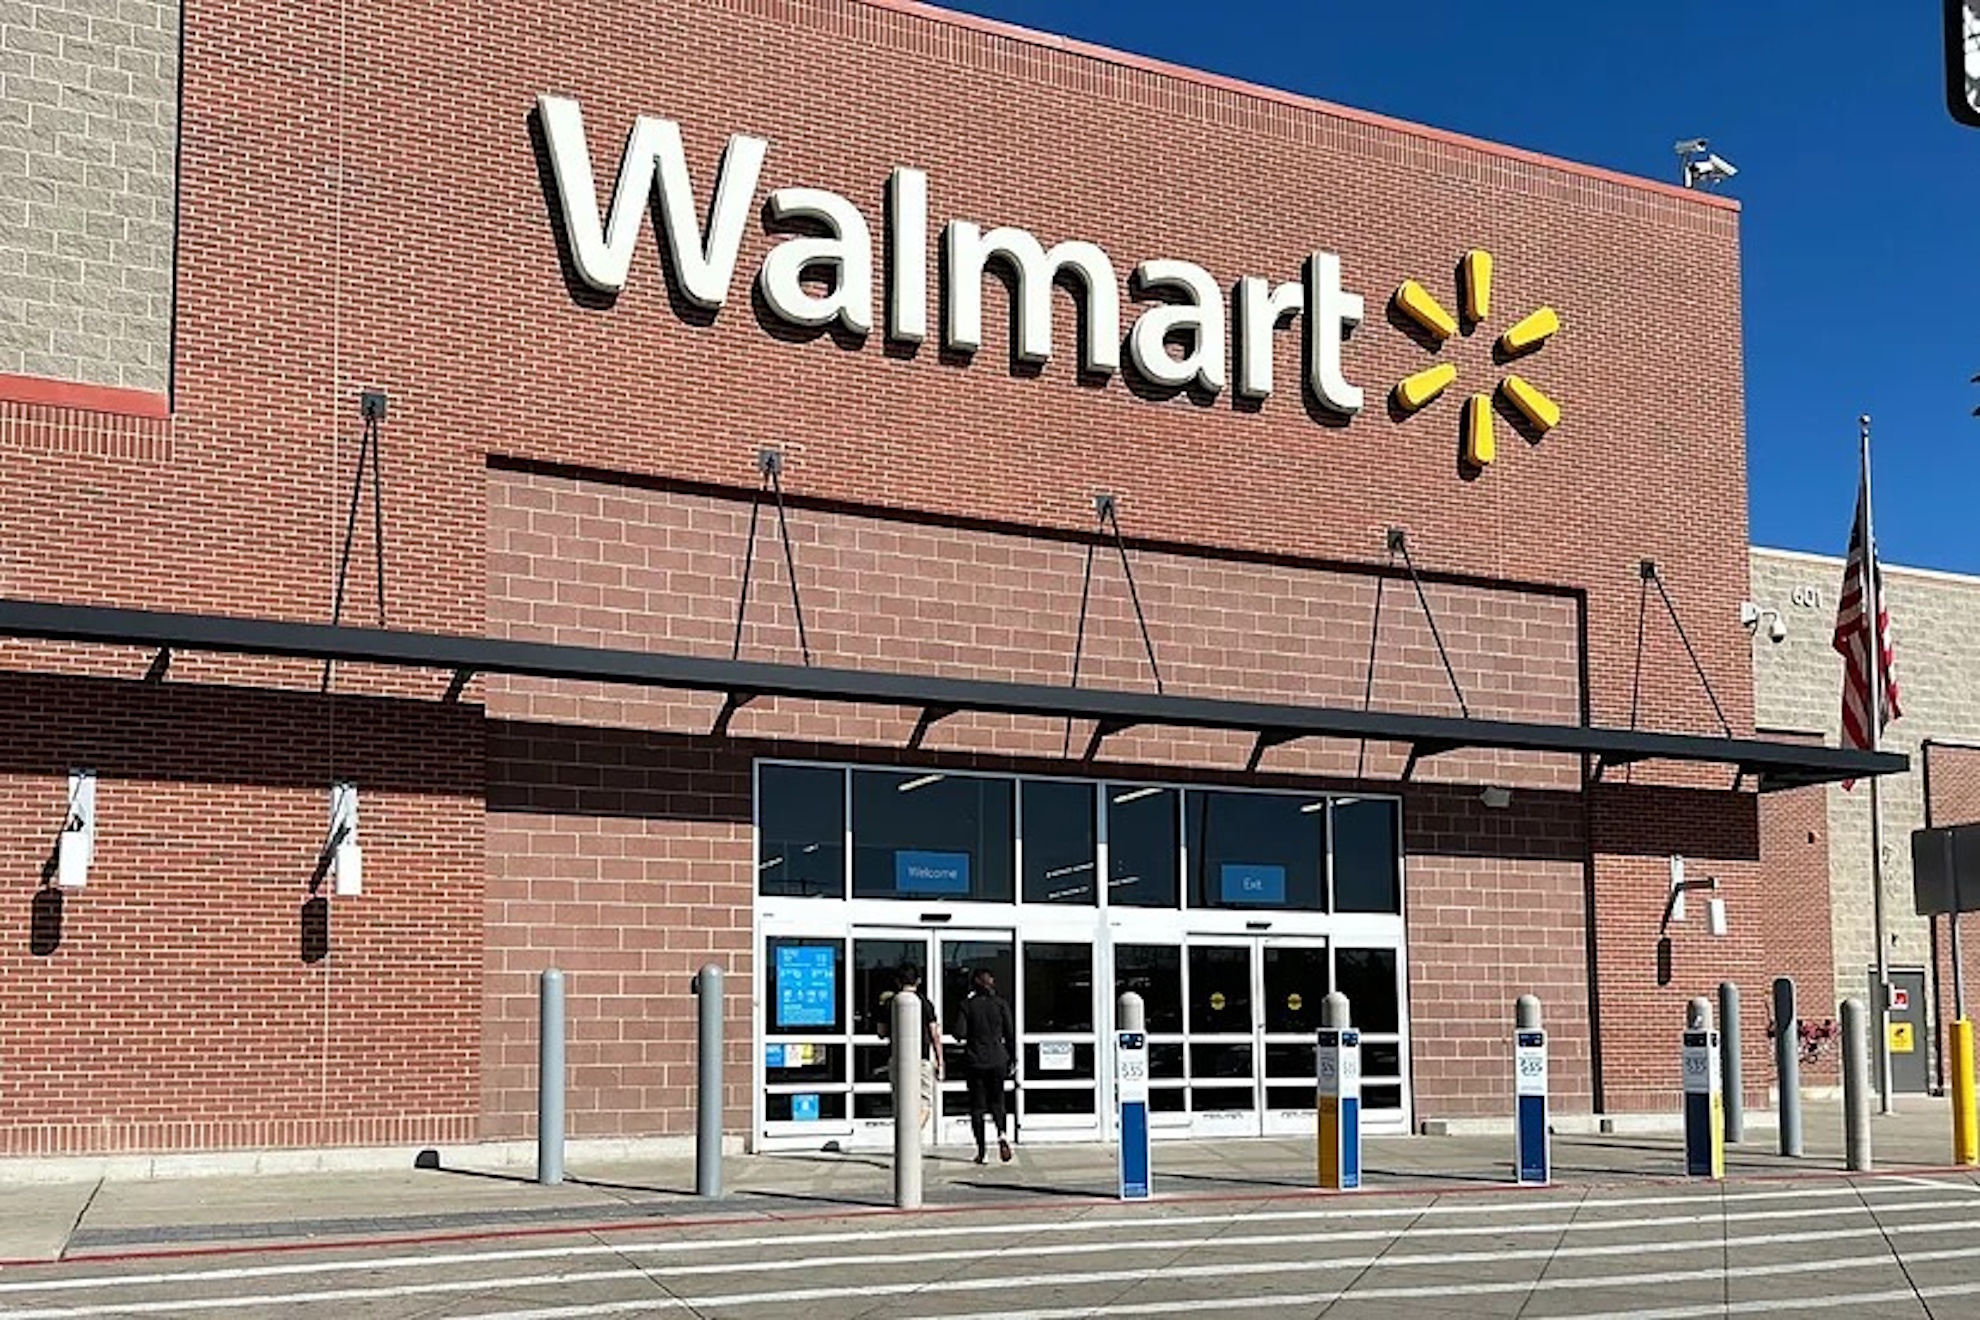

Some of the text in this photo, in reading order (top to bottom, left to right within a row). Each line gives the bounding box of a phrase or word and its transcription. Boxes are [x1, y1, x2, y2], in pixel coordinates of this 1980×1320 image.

[538, 95, 1364, 412] Walmart
[1792, 585, 1823, 608] 601
[908, 866, 958, 880] Welcome
[1243, 877, 1263, 890] Exit
